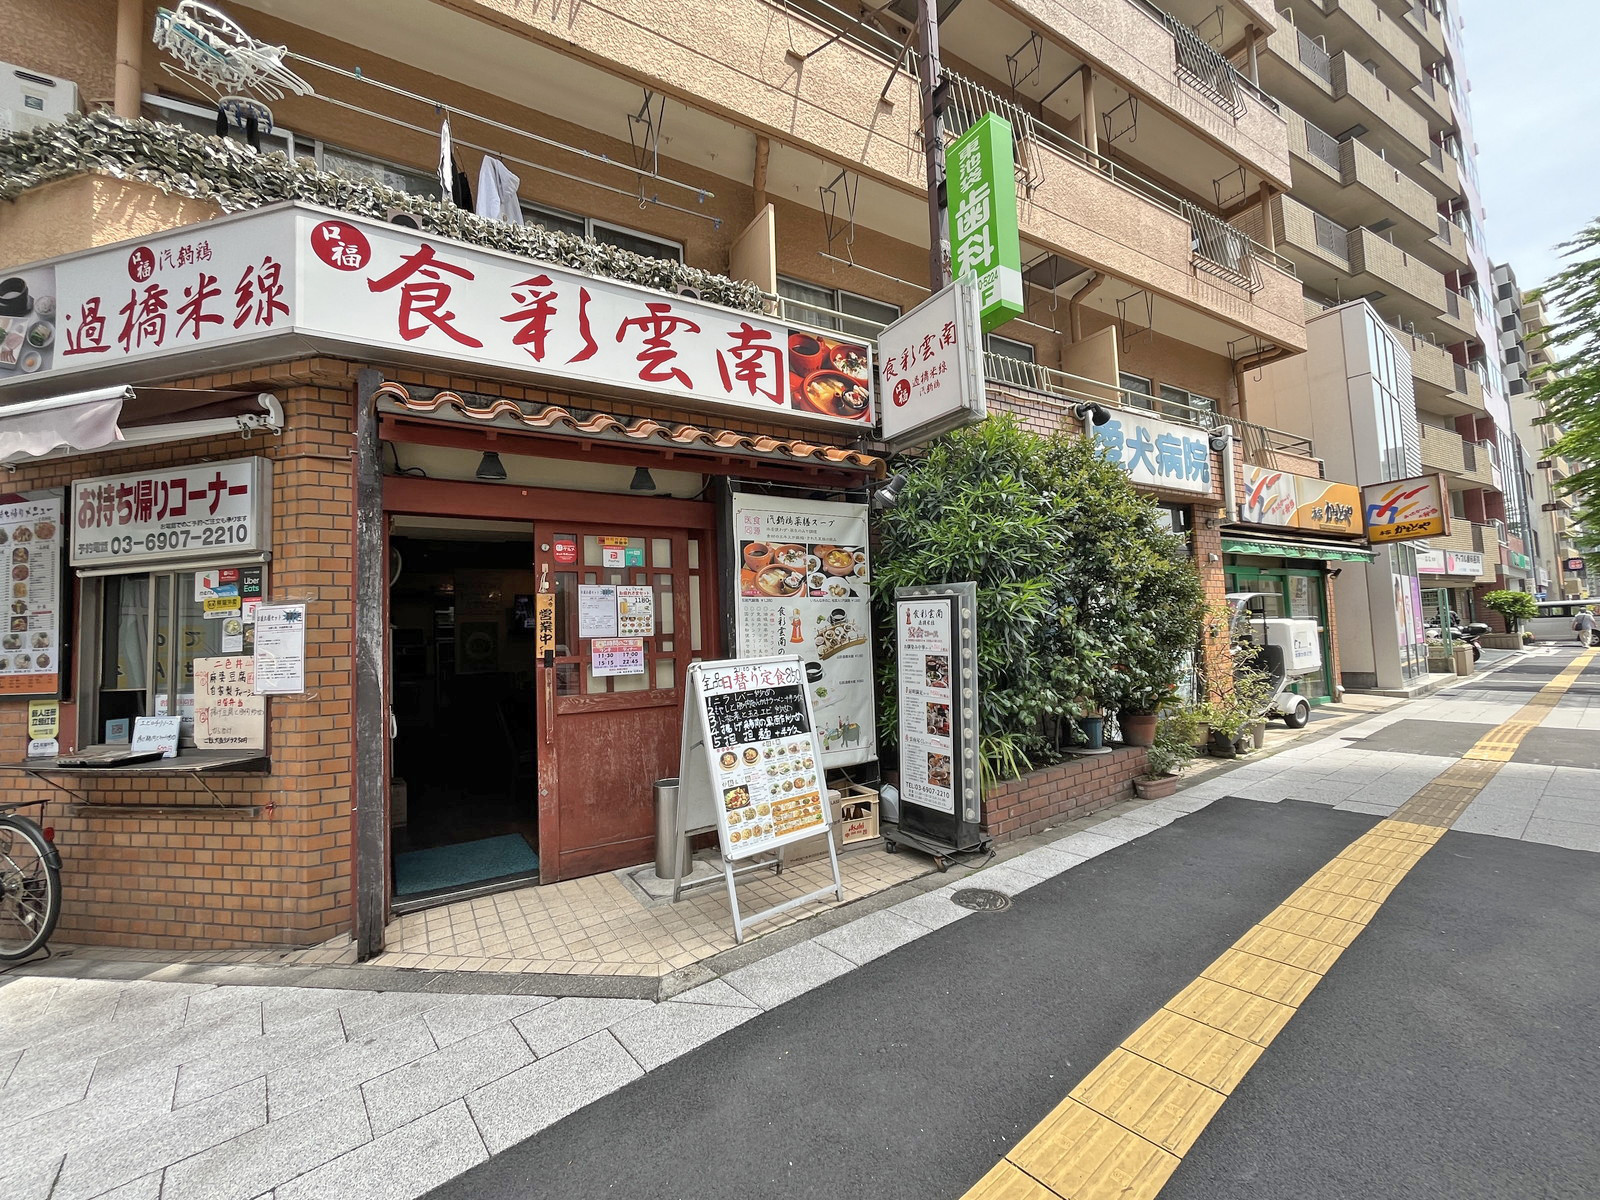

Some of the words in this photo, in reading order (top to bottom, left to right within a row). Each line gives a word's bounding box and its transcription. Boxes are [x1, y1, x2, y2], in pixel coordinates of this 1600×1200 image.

[958, 136, 982, 193] 東池袋
[322, 226, 361, 269] 口福
[955, 182, 995, 276] 歯科
[131, 251, 151, 279] 口福
[159, 240, 213, 272] 汽鍋鶏
[63, 256, 291, 356] 過橋米線
[367, 243, 785, 405] 食彩雲南
[883, 321, 957, 382] 食彩雲南
[77, 471, 248, 529] お持ち帰りコーナー
[111, 523, 248, 555] 03-6907-2210
[1395, 522, 1431, 535] かまどや
[244, 577, 260, 585] Uber
[539, 608, 553, 646] 営業中
[913, 609, 944, 619] 食彩雲南
[210, 671, 247, 683] 麻婆豆腐
